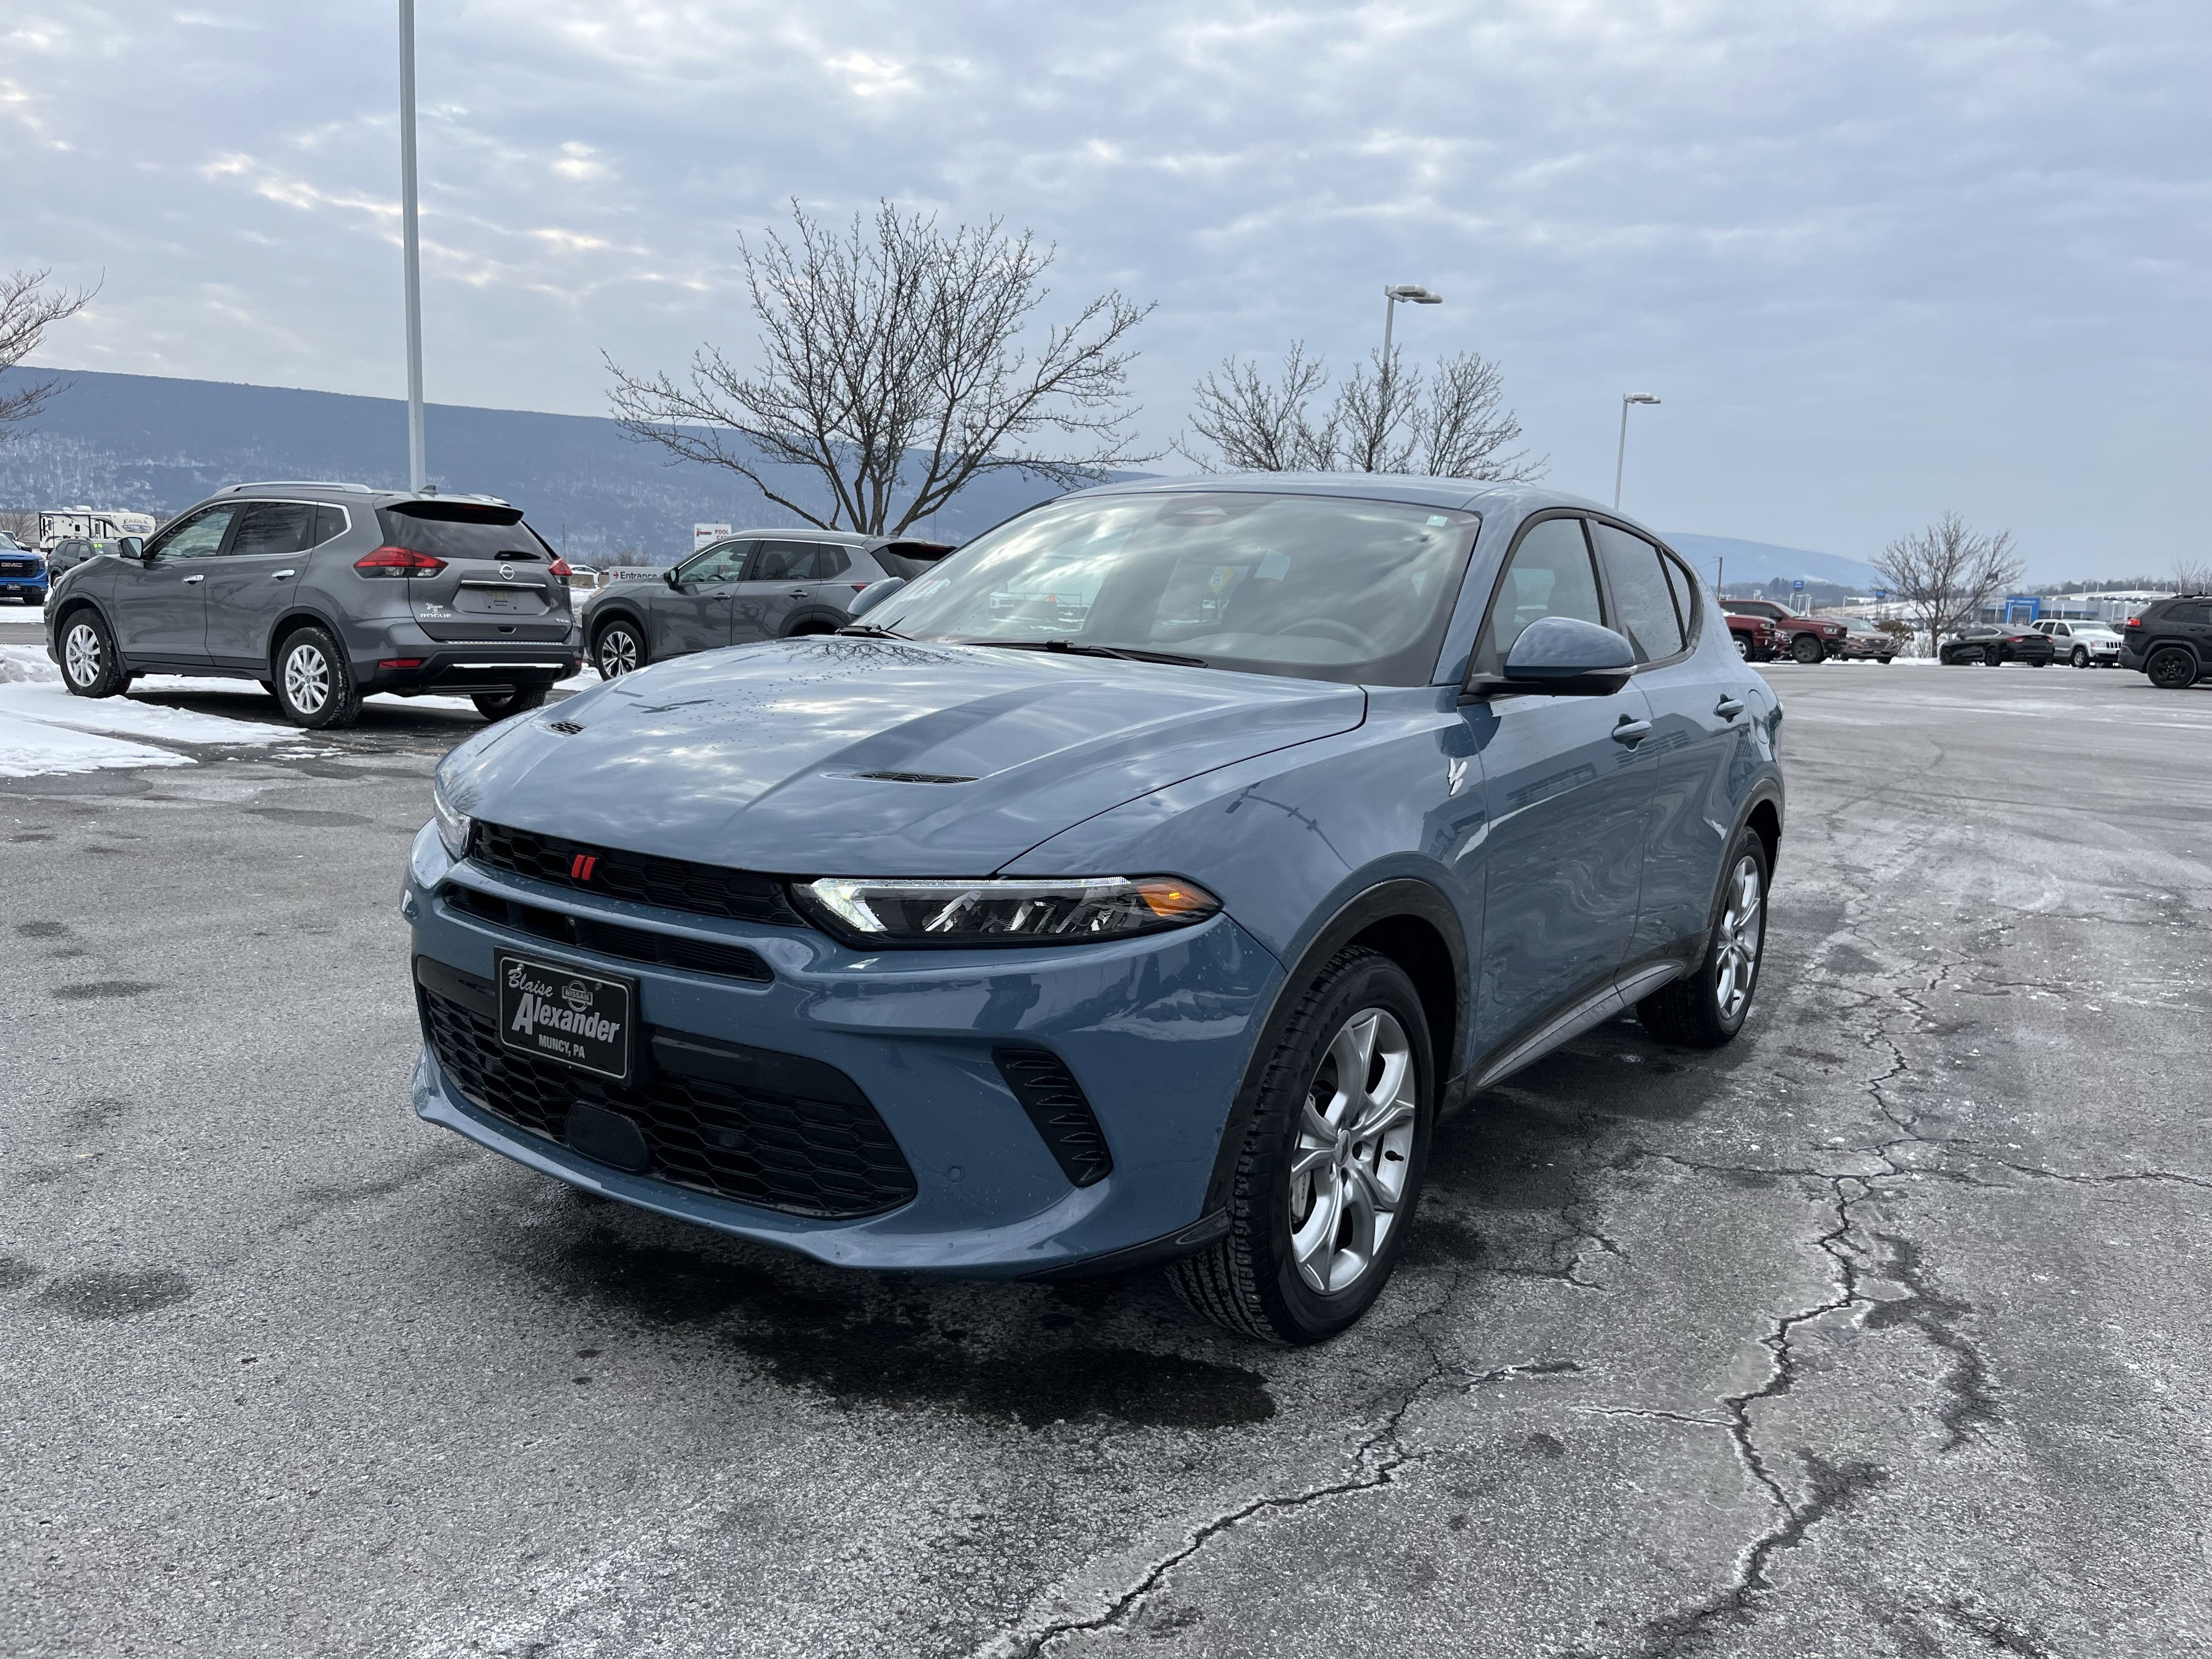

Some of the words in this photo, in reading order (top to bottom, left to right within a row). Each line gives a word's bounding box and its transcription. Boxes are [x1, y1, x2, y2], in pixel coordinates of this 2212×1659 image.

[508, 968, 554, 997] Blaise
[565, 989, 589, 1001] NISSAN
[511, 992, 620, 1043] Alexander
[539, 1034, 571, 1057] MUNCY,
[573, 1043, 585, 1059] PA
